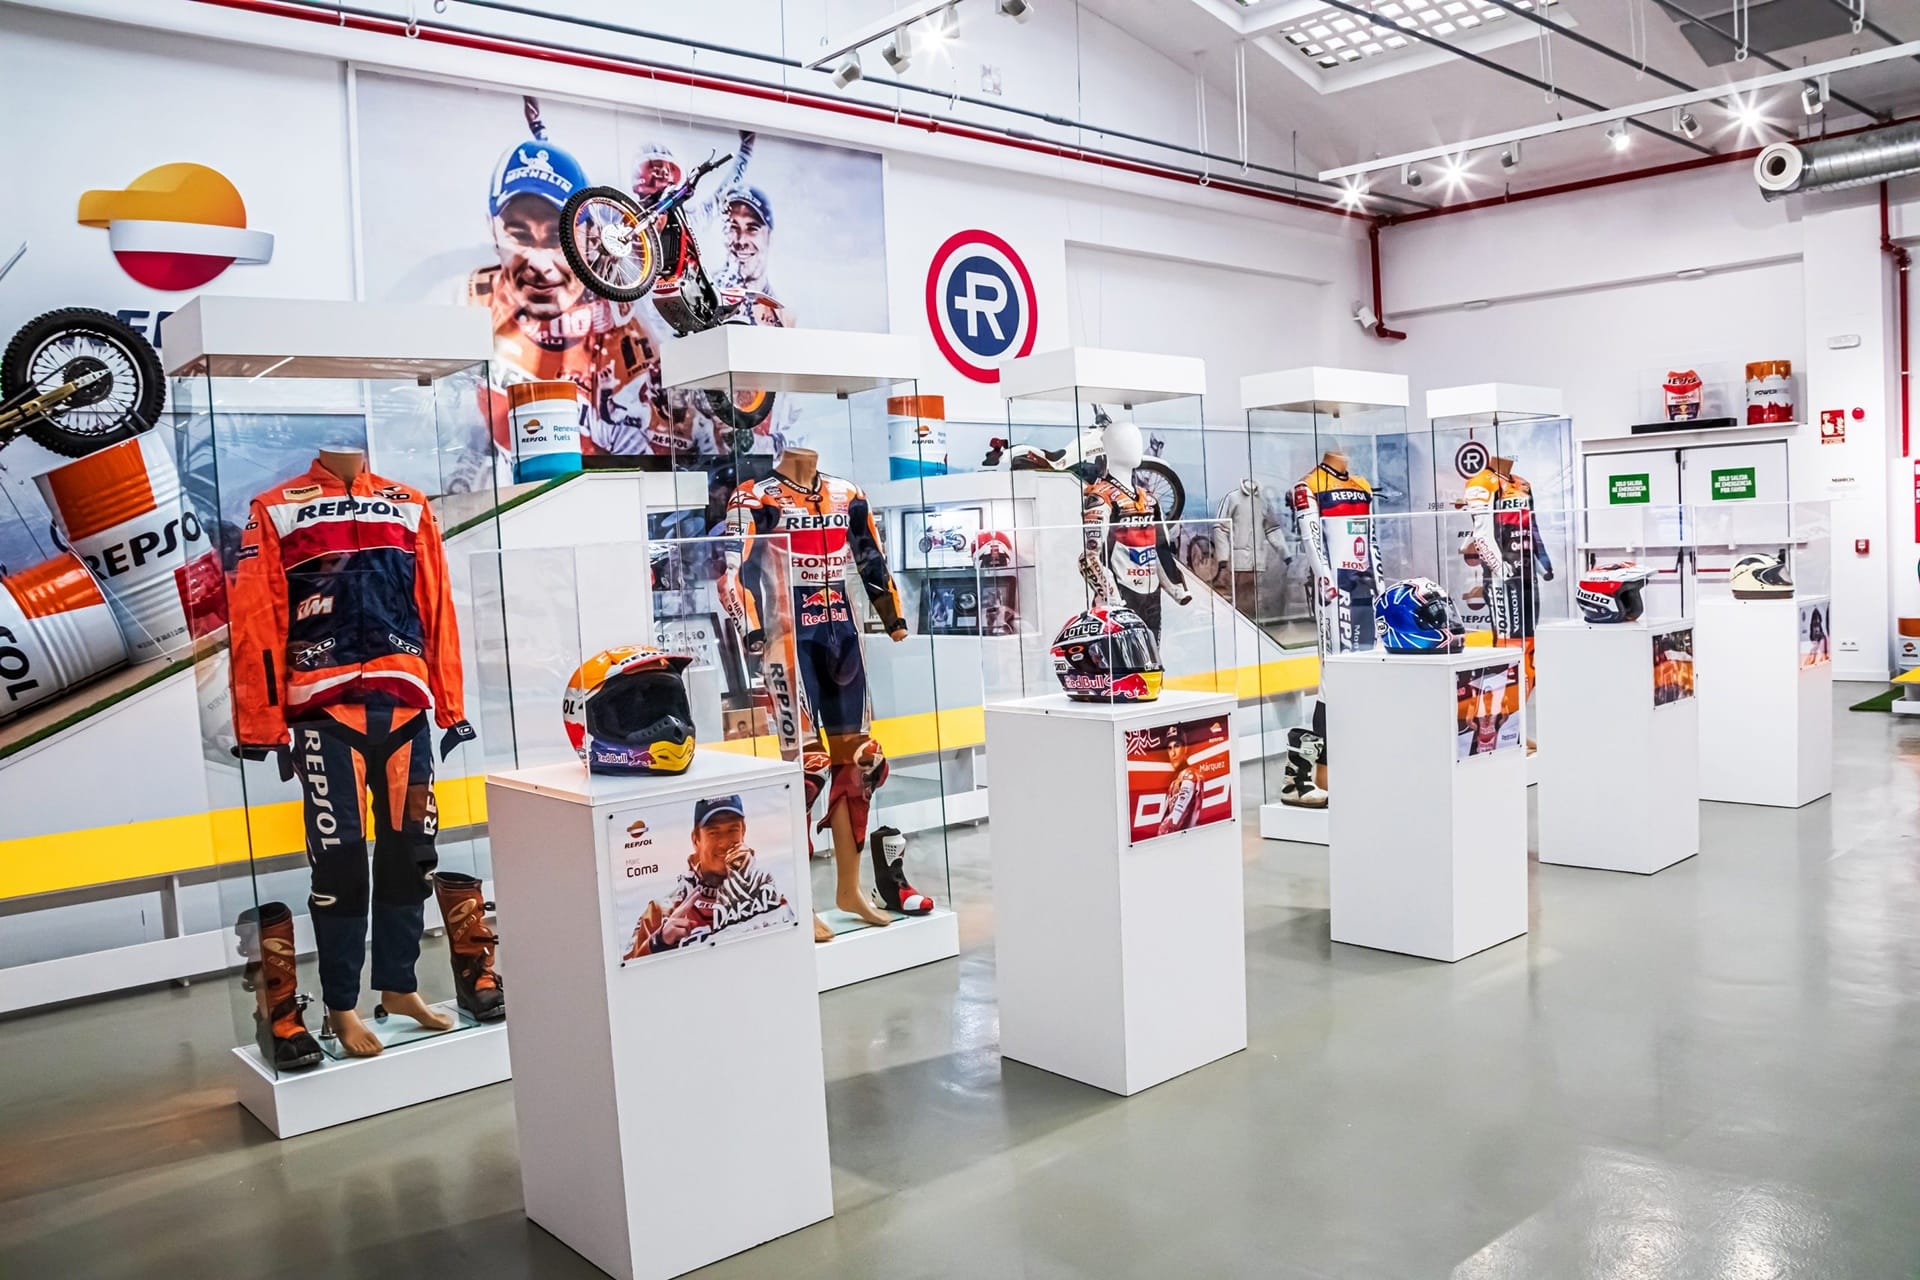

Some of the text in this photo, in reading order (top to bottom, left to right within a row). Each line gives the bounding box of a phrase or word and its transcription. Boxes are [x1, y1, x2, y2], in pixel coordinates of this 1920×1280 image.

[521, 434, 547, 443] REPSOL
[554, 434, 571, 442] fuels
[783, 479, 808, 493] REPSOL
[1110, 479, 1136, 499] REPSOL
[1331, 491, 1367, 501] REPSOL
[296, 501, 403, 523] REPSOL
[786, 514, 849, 530] REPSOL
[801, 571, 819, 580] One
[1577, 590, 1610, 605] hebo
[297, 593, 334, 621] KTM
[1495, 586, 1507, 634] REPSOL
[1511, 589, 1520, 633] HONDA
[801, 608, 849, 626] Red Bull
[1063, 623, 1100, 639] LOTUS
[769, 663, 796, 748] REPSOL
[1199, 761, 1225, 773] Márquez
[305, 729, 342, 850] REPSOL
[624, 839, 652, 849] REPSOL
[626, 864, 659, 878] Coma
[713, 884, 779, 930] DAKAR
